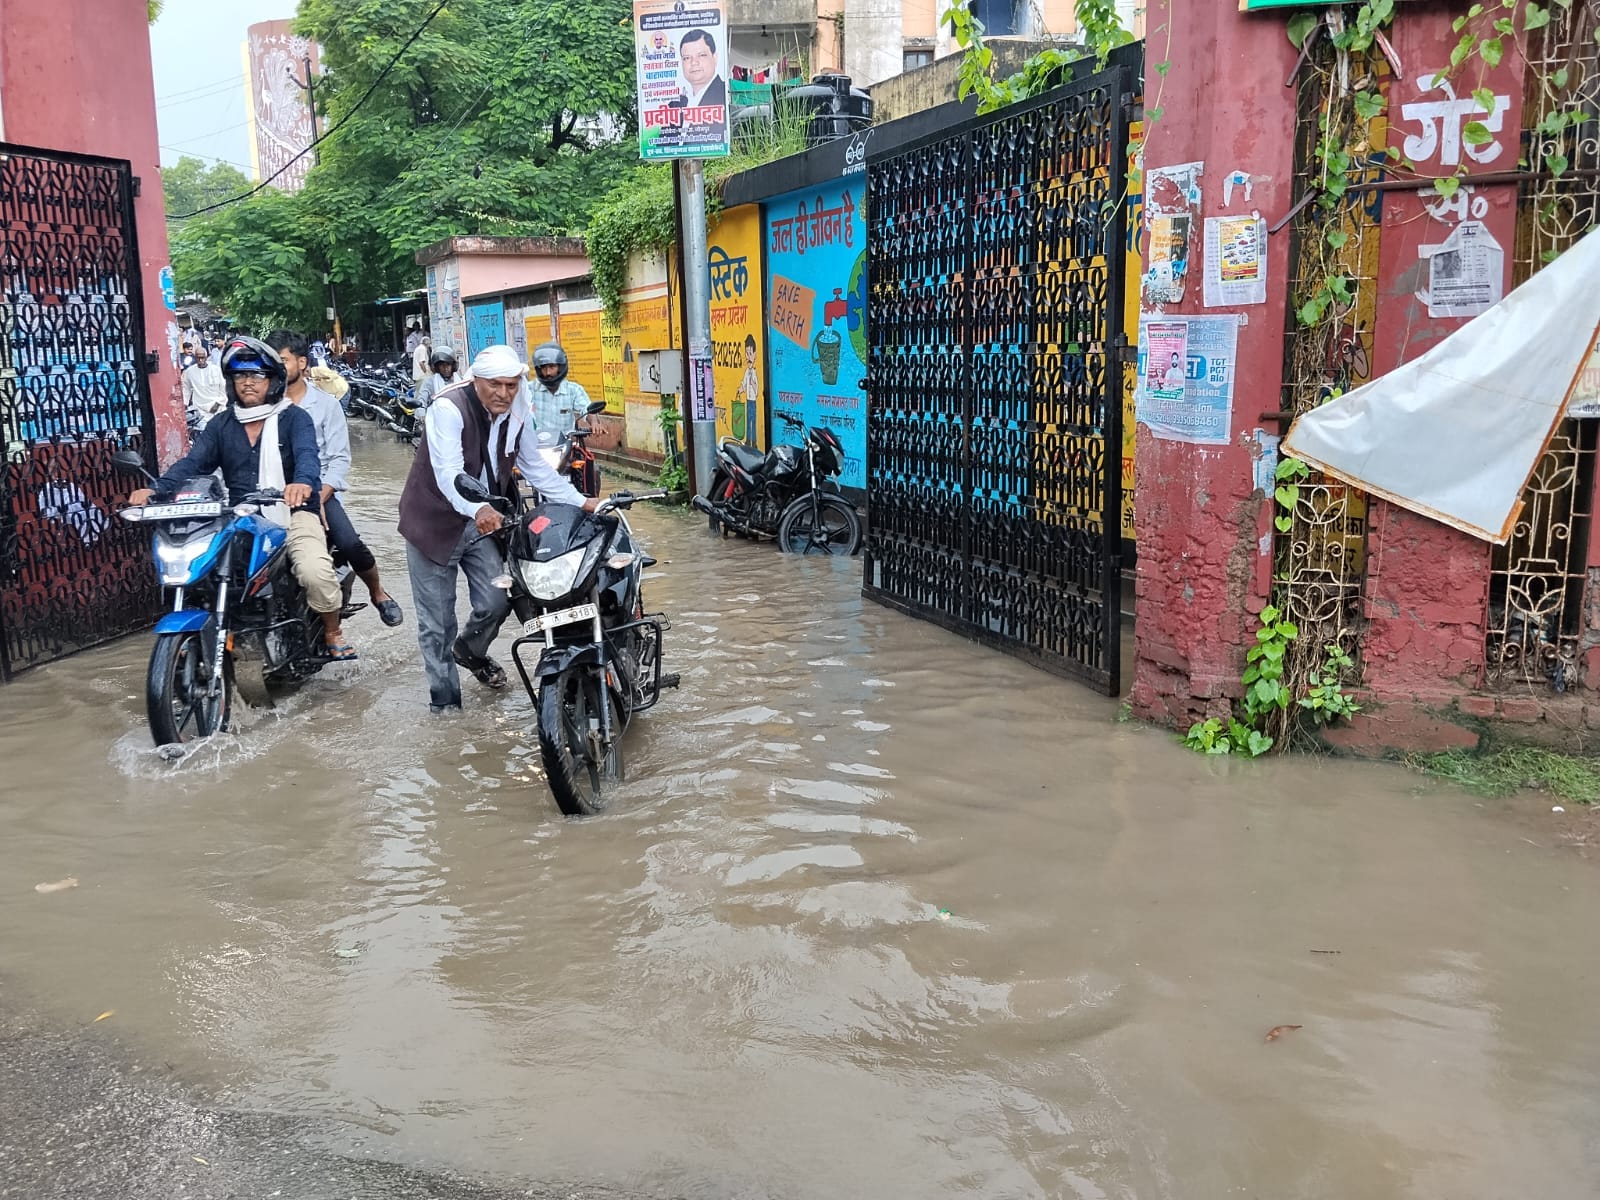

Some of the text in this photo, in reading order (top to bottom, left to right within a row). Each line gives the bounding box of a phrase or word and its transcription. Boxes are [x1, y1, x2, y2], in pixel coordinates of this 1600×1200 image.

[643, 104, 725, 128] प्रदीप यादव
[1402, 74, 1510, 165] गेट
[771, 189, 855, 255] जल ही जीवन है
[777, 284, 800, 303] SAVE
[711, 299, 748, 332] मुक्त प्रदेश
[774, 305, 804, 339] EARTH
[1211, 358, 1226, 366] TGT
